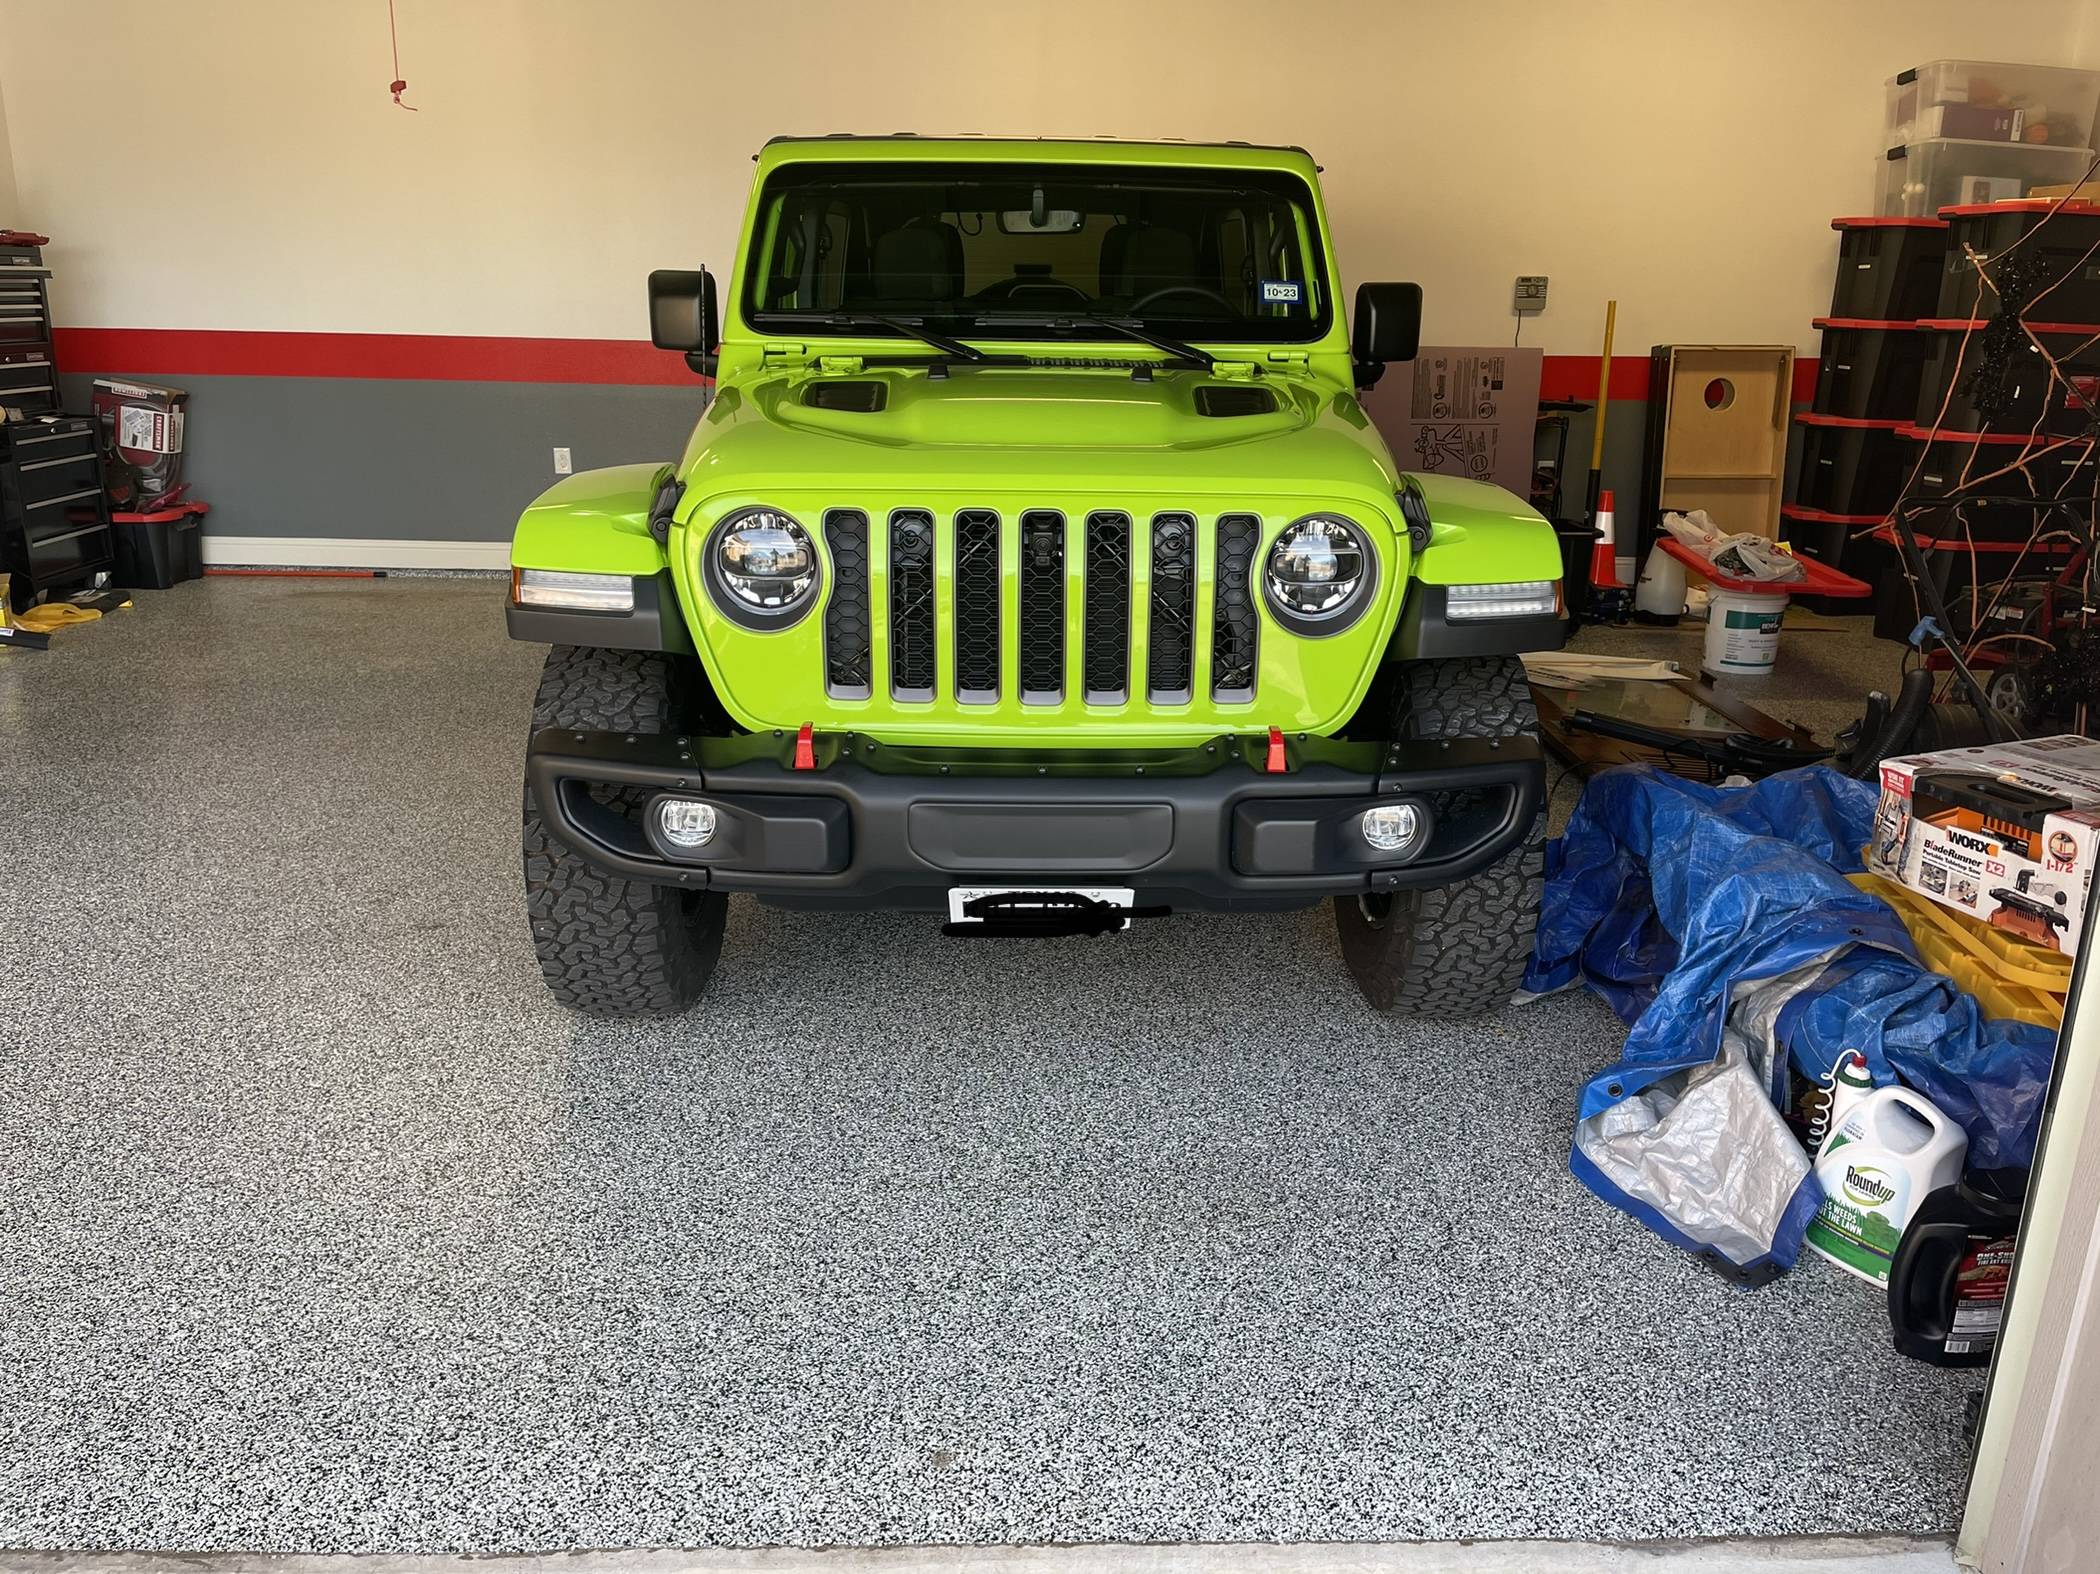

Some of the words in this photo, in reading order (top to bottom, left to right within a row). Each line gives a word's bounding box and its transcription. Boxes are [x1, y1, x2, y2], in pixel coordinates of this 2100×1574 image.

[1923, 839, 1983, 868] BladeRunner
[1948, 829, 1992, 855] WORX
[1987, 862, 2004, 876] X2
[1846, 1165, 1896, 1204] Roundup
[1828, 1211, 1840, 1225] THE
[1841, 1218, 1863, 1237] LAWN
[1833, 1203, 1857, 1224] WEEDS
